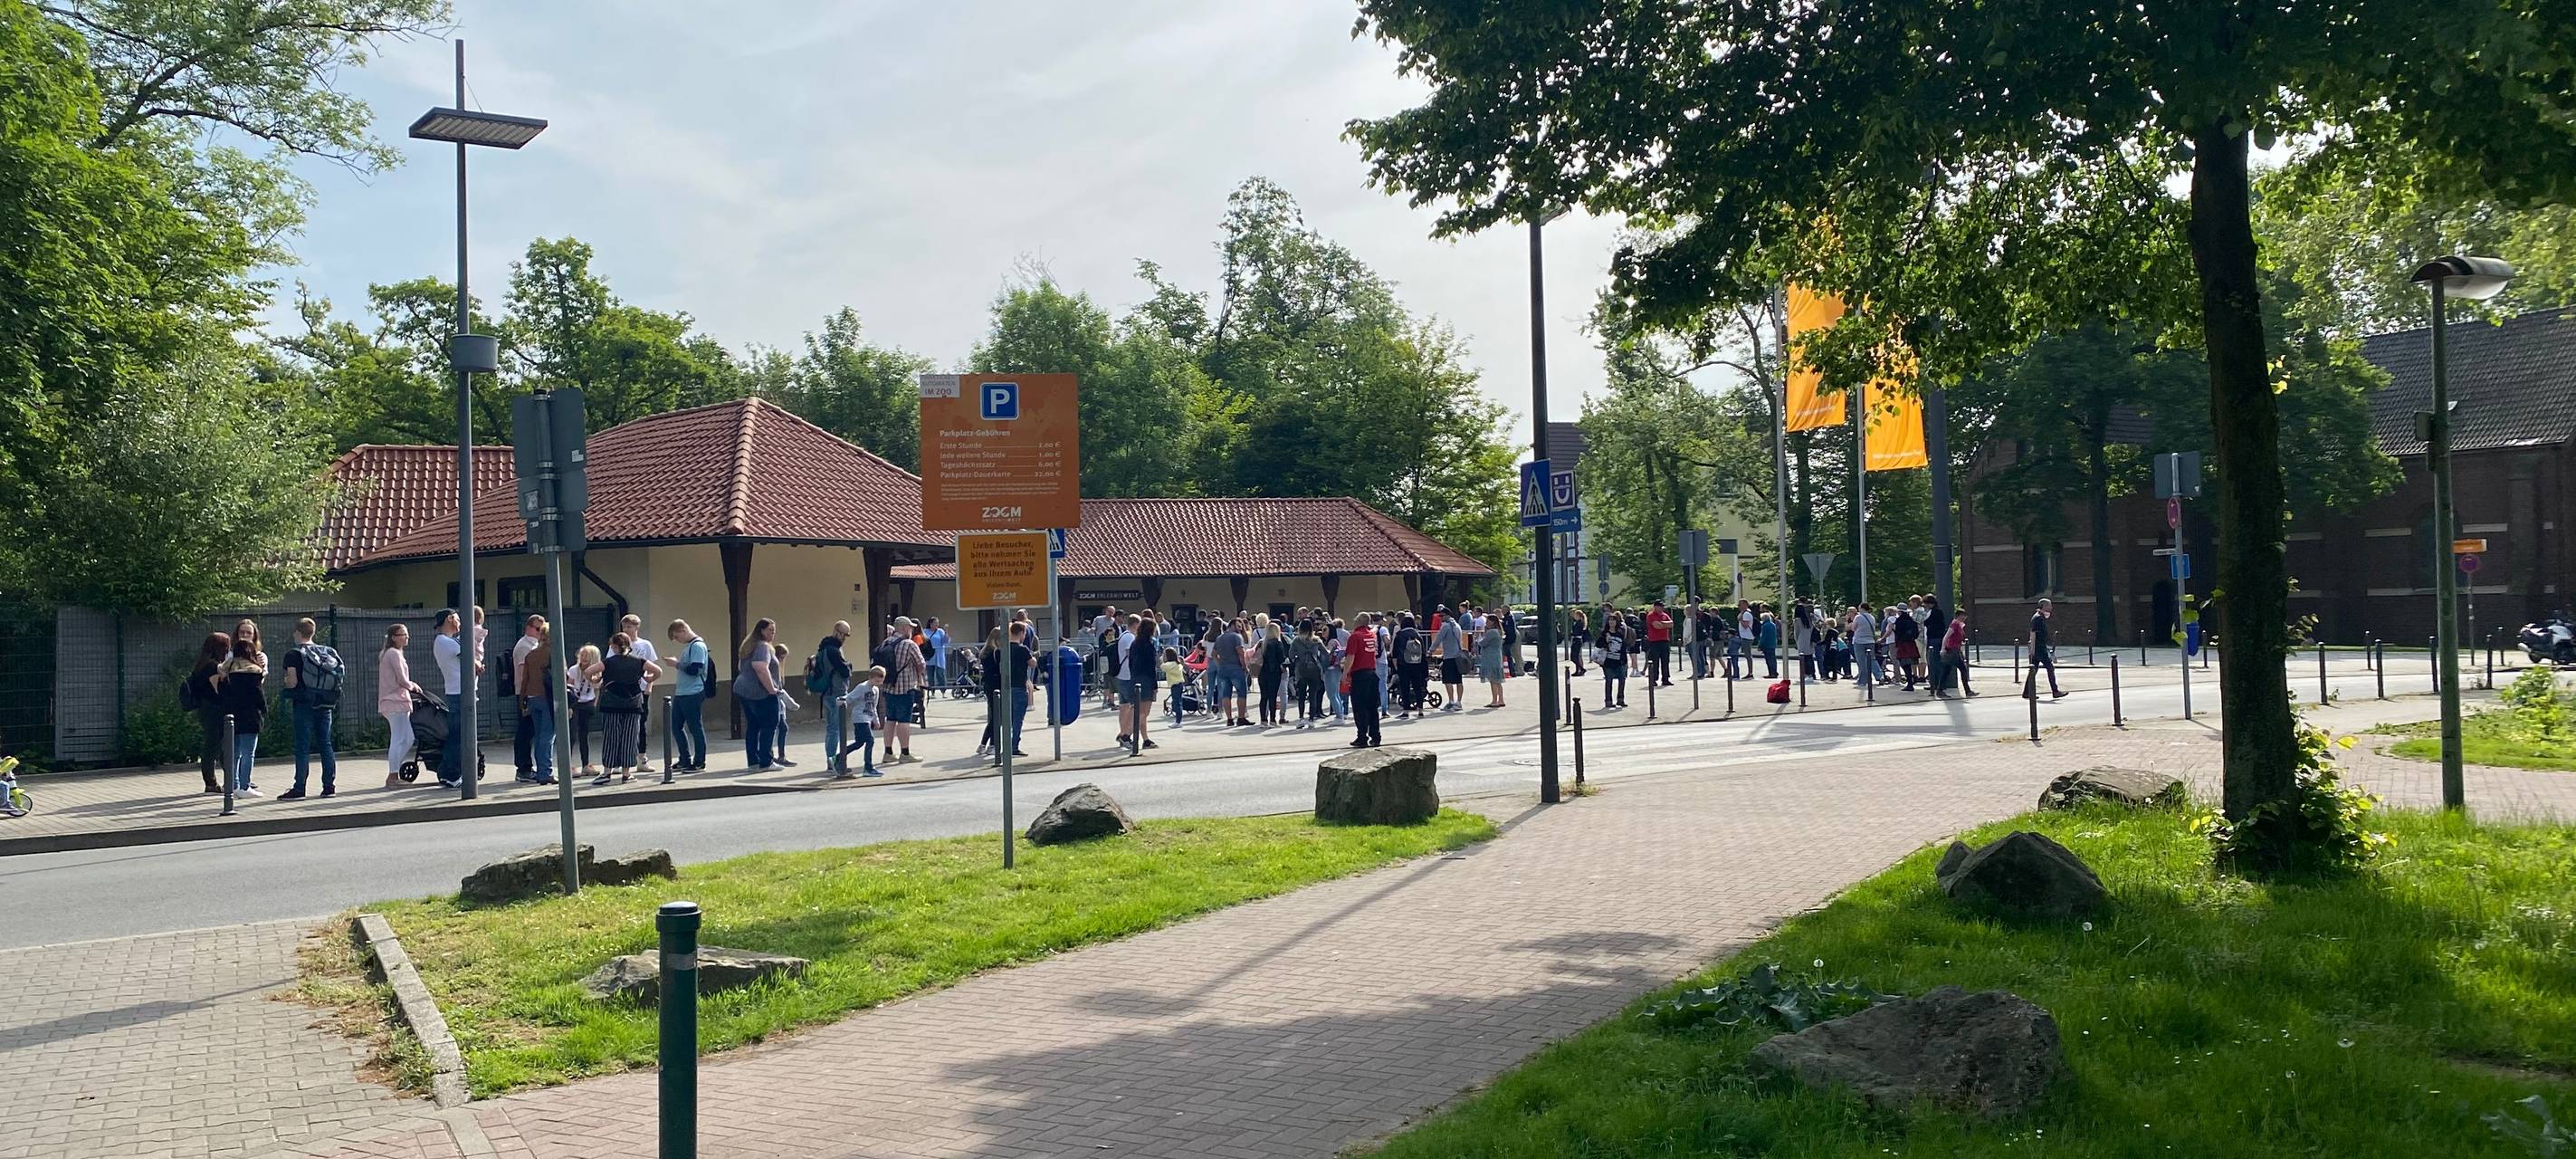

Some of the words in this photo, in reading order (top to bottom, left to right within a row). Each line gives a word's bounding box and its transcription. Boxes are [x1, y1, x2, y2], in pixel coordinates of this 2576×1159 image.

[990, 388, 1010, 414] P
[940, 429, 1011, 437] Parkplatz-Gebühren
[940, 452, 954, 460] Jede
[940, 462, 996, 470] Tageshöchstsatz
[940, 471, 1011, 479] Parkplatz-Dauerkarte
[982, 506, 1022, 518] ZOOM
[996, 541, 1034, 549] Besucher,
[970, 551, 989, 559] bitte
[991, 550, 1022, 558] nehmen
[1024, 549, 1035, 557] Sie
[973, 560, 987, 569] alle
[989, 560, 1035, 568] Wertsachen
[992, 592, 1016, 600] ZOOM
